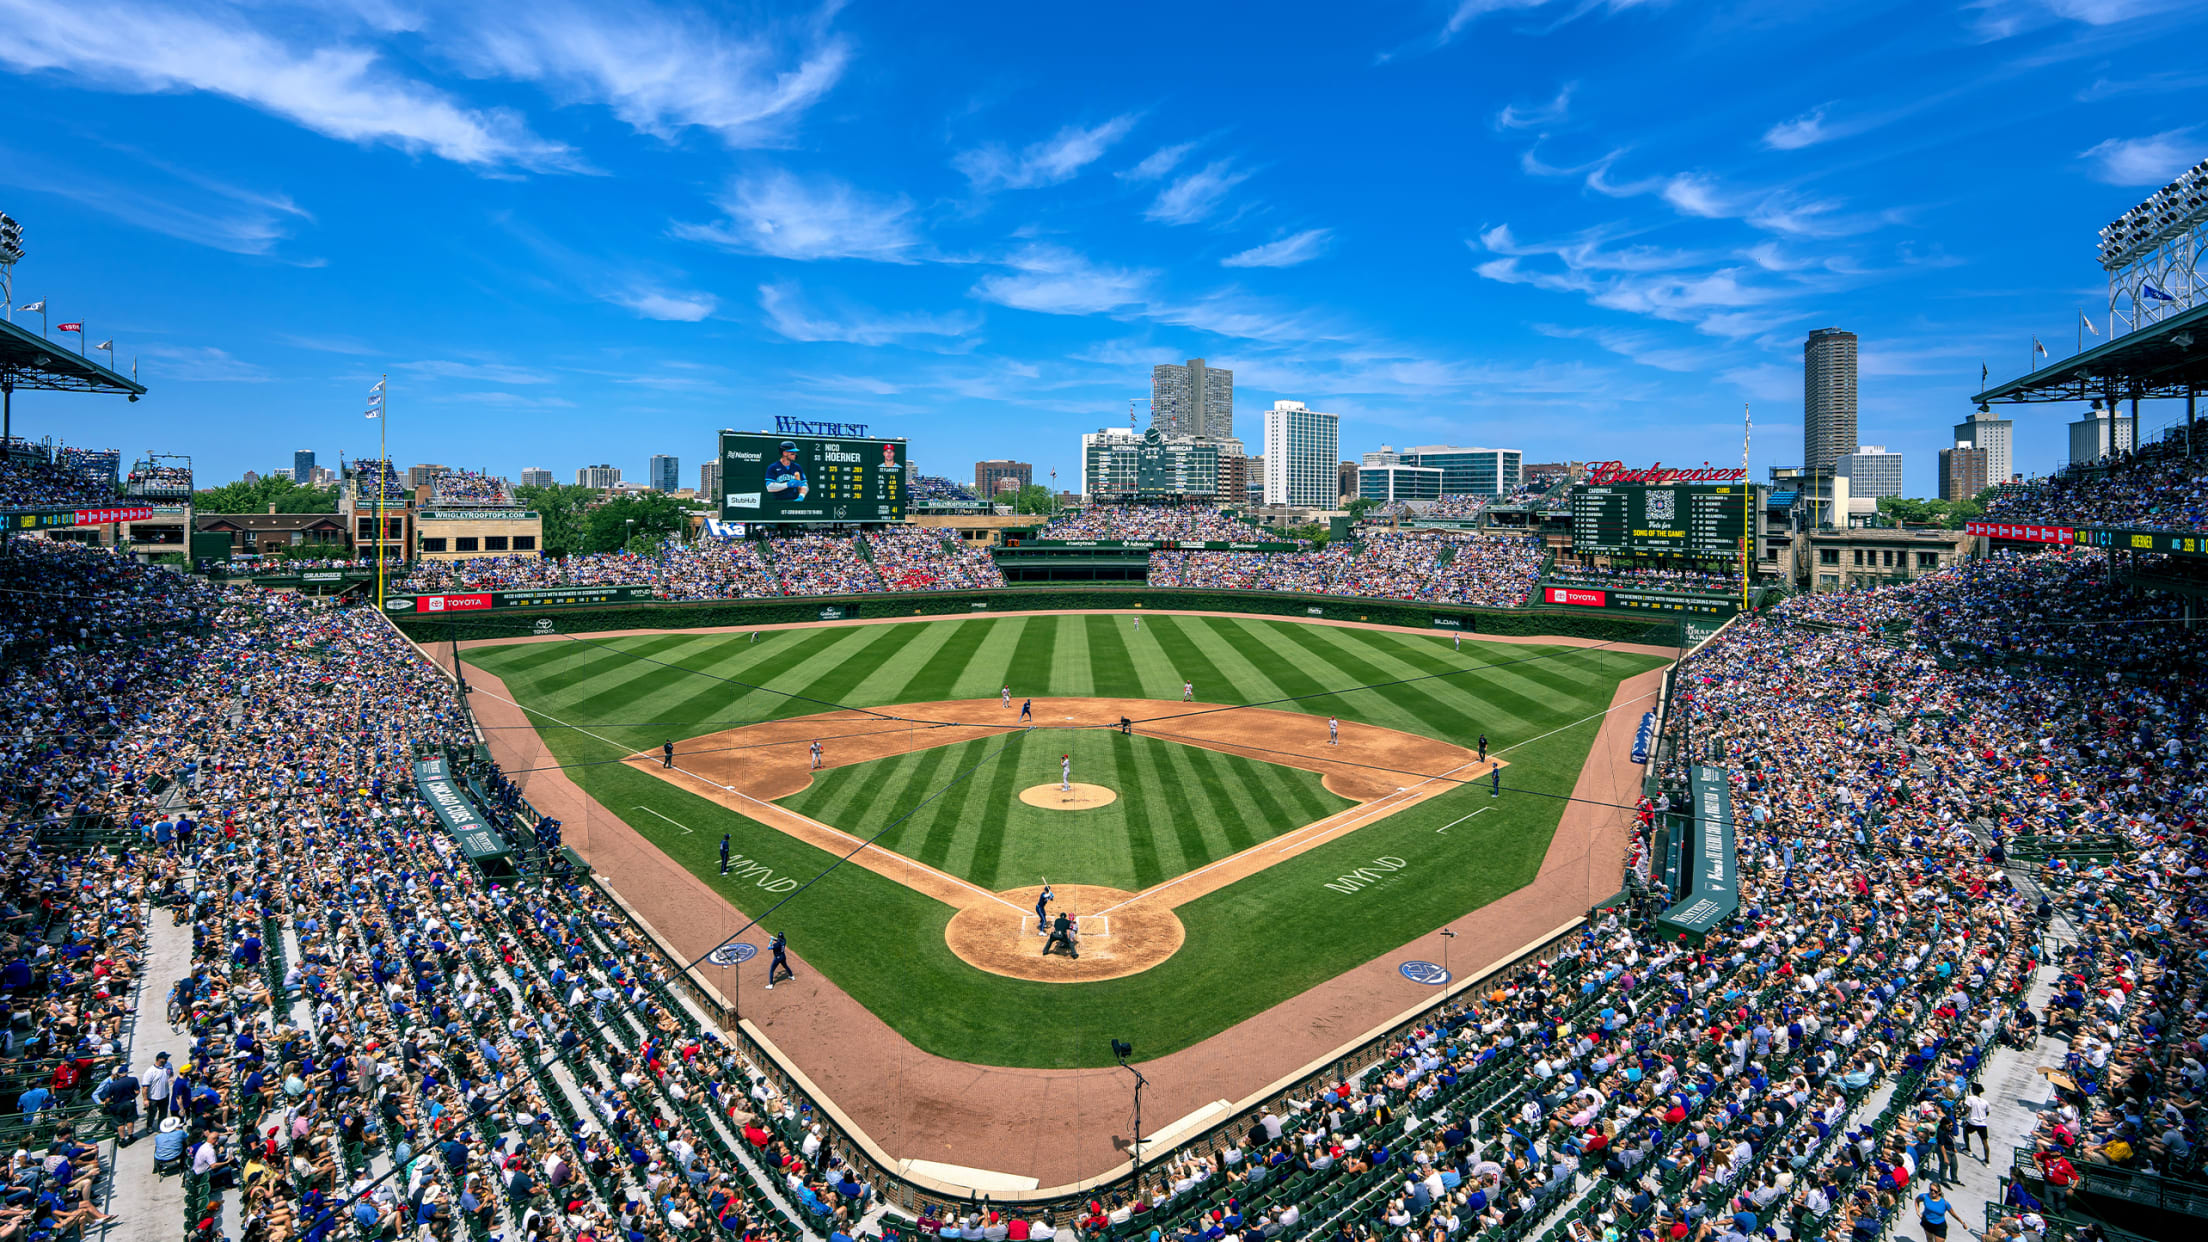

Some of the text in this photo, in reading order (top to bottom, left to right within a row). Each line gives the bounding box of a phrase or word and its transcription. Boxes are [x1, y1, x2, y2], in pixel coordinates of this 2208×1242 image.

[774, 415, 868, 437] WINTRUST
[815, 443, 840, 451] 2 NICO
[825, 452, 861, 462] HOERNER
[1584, 460, 1745, 485] Budweiser
[435, 511, 525, 519] WRIGLEYROOFTOPS.COM
[2131, 535, 2152, 548] HOERNER
[2172, 539, 2180, 550] AVG
[2183, 538, 2195, 552] .269
[1569, 593, 1597, 601] TOYOTA
[427, 782, 475, 824] CHICAGO CUBS
[714, 854, 798, 892] MYND
[1324, 856, 1407, 894] MYND
[1670, 898, 1714, 922] WINTRUST
[1532, 1108, 1541, 1120] 44
